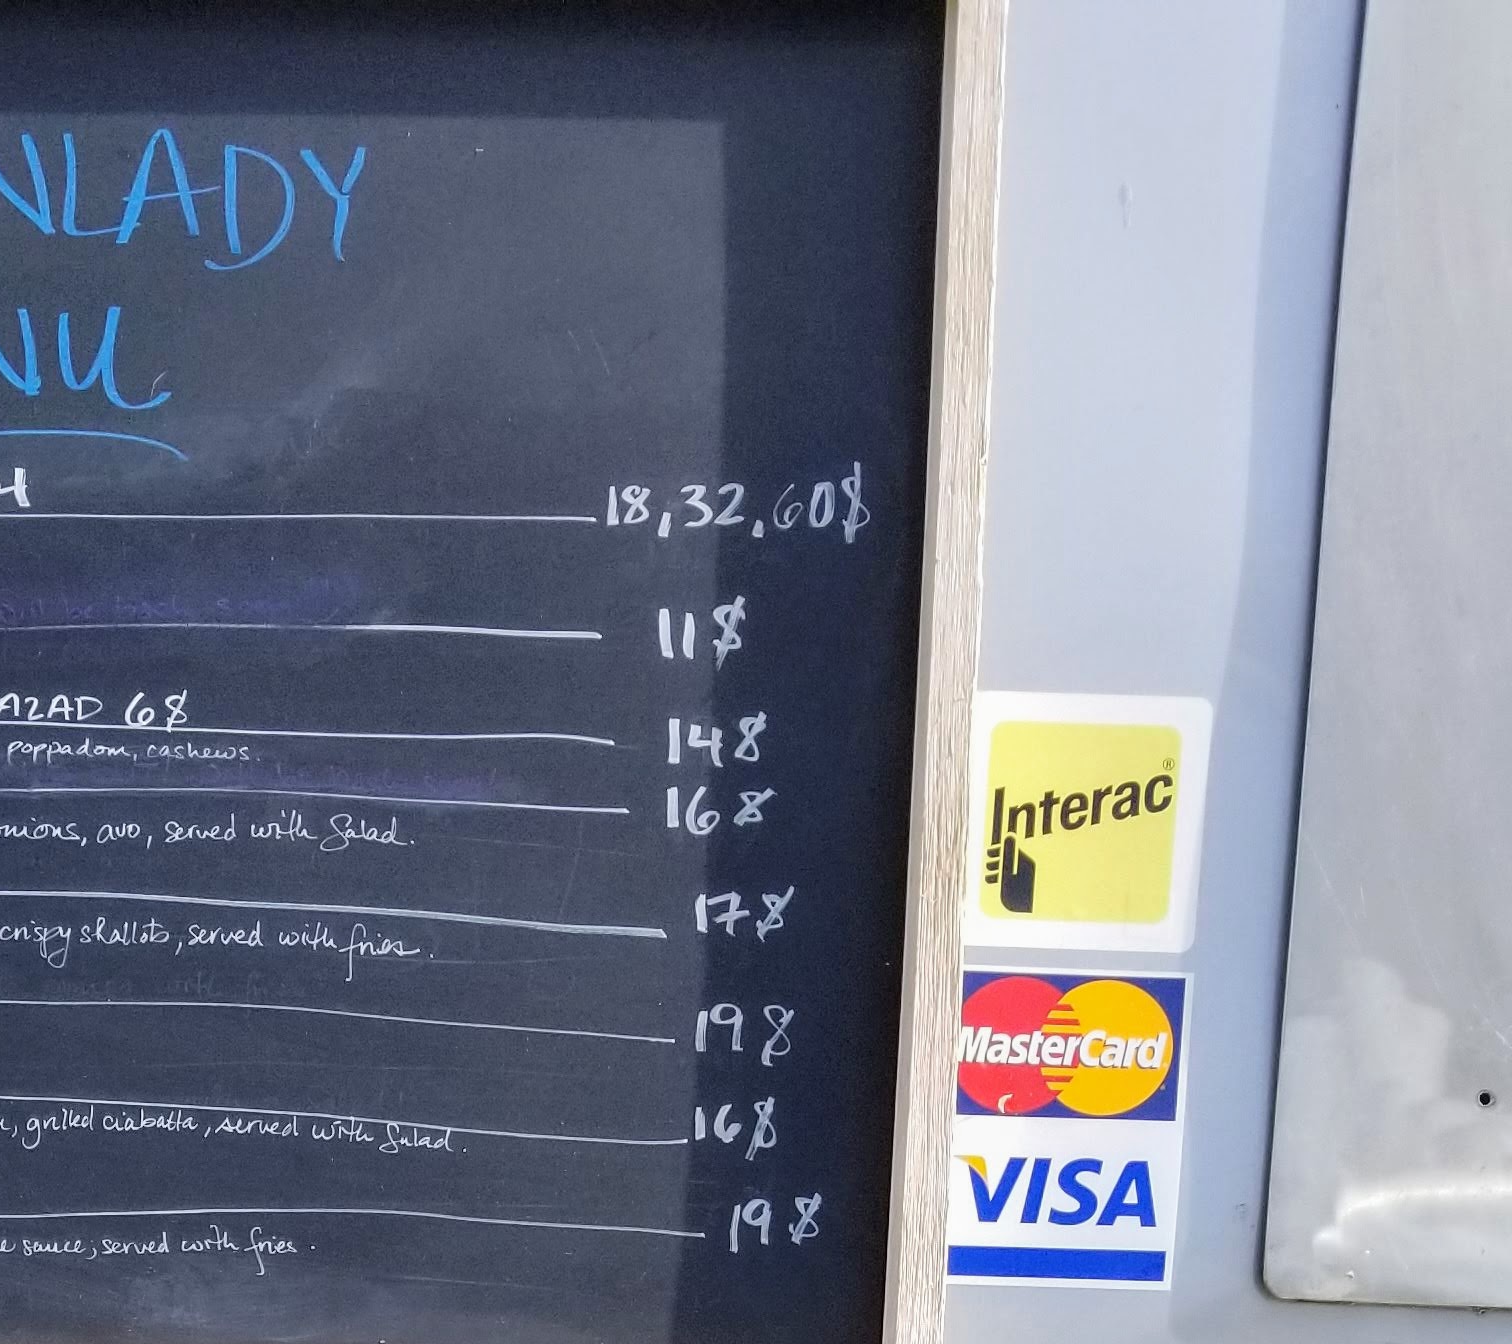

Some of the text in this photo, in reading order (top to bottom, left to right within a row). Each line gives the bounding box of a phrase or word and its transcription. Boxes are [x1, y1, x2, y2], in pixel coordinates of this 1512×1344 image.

[6, 738, 138, 763] poppadom,
[164, 815, 236, 841] served
[251, 809, 318, 840] with
[991, 773, 1175, 845] Interac
[0, 914, 71, 968] crispy
[188, 921, 264, 947] served
[278, 921, 339, 950] with
[959, 1027, 1167, 1069] MasterCard
[22, 1105, 94, 1150] grilled
[215, 1115, 299, 1136] served
[312, 1117, 375, 1143] with
[954, 1155, 1157, 1228] VISA
[101, 1235, 170, 1255] served
[181, 1225, 240, 1252] with
